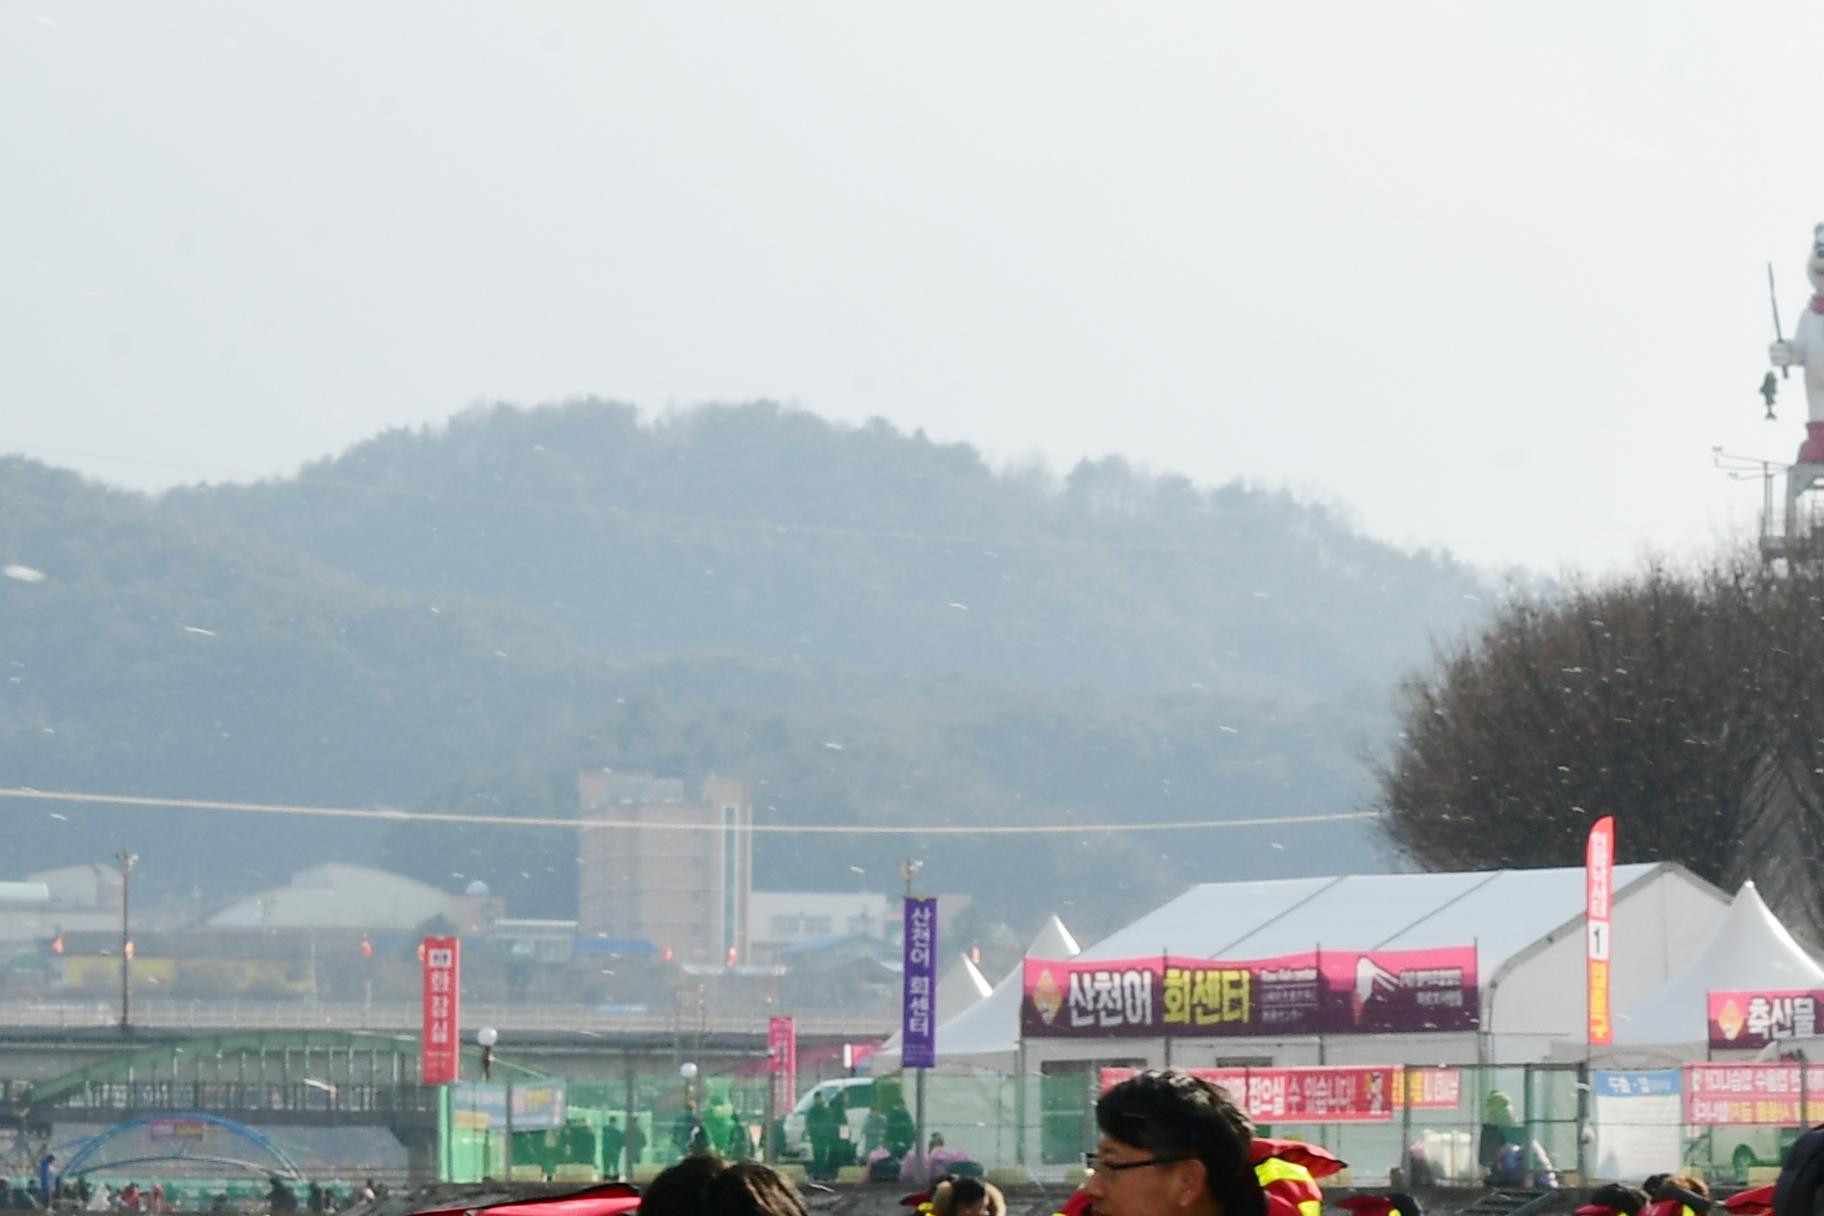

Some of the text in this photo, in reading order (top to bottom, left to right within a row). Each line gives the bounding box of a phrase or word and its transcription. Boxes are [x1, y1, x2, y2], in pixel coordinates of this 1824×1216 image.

[911, 907, 932, 968] 산천어
[909, 976, 930, 1037] 회센터
[1067, 966, 1251, 1027] 산천어 회센터
[1748, 995, 1817, 1040] 축산물
